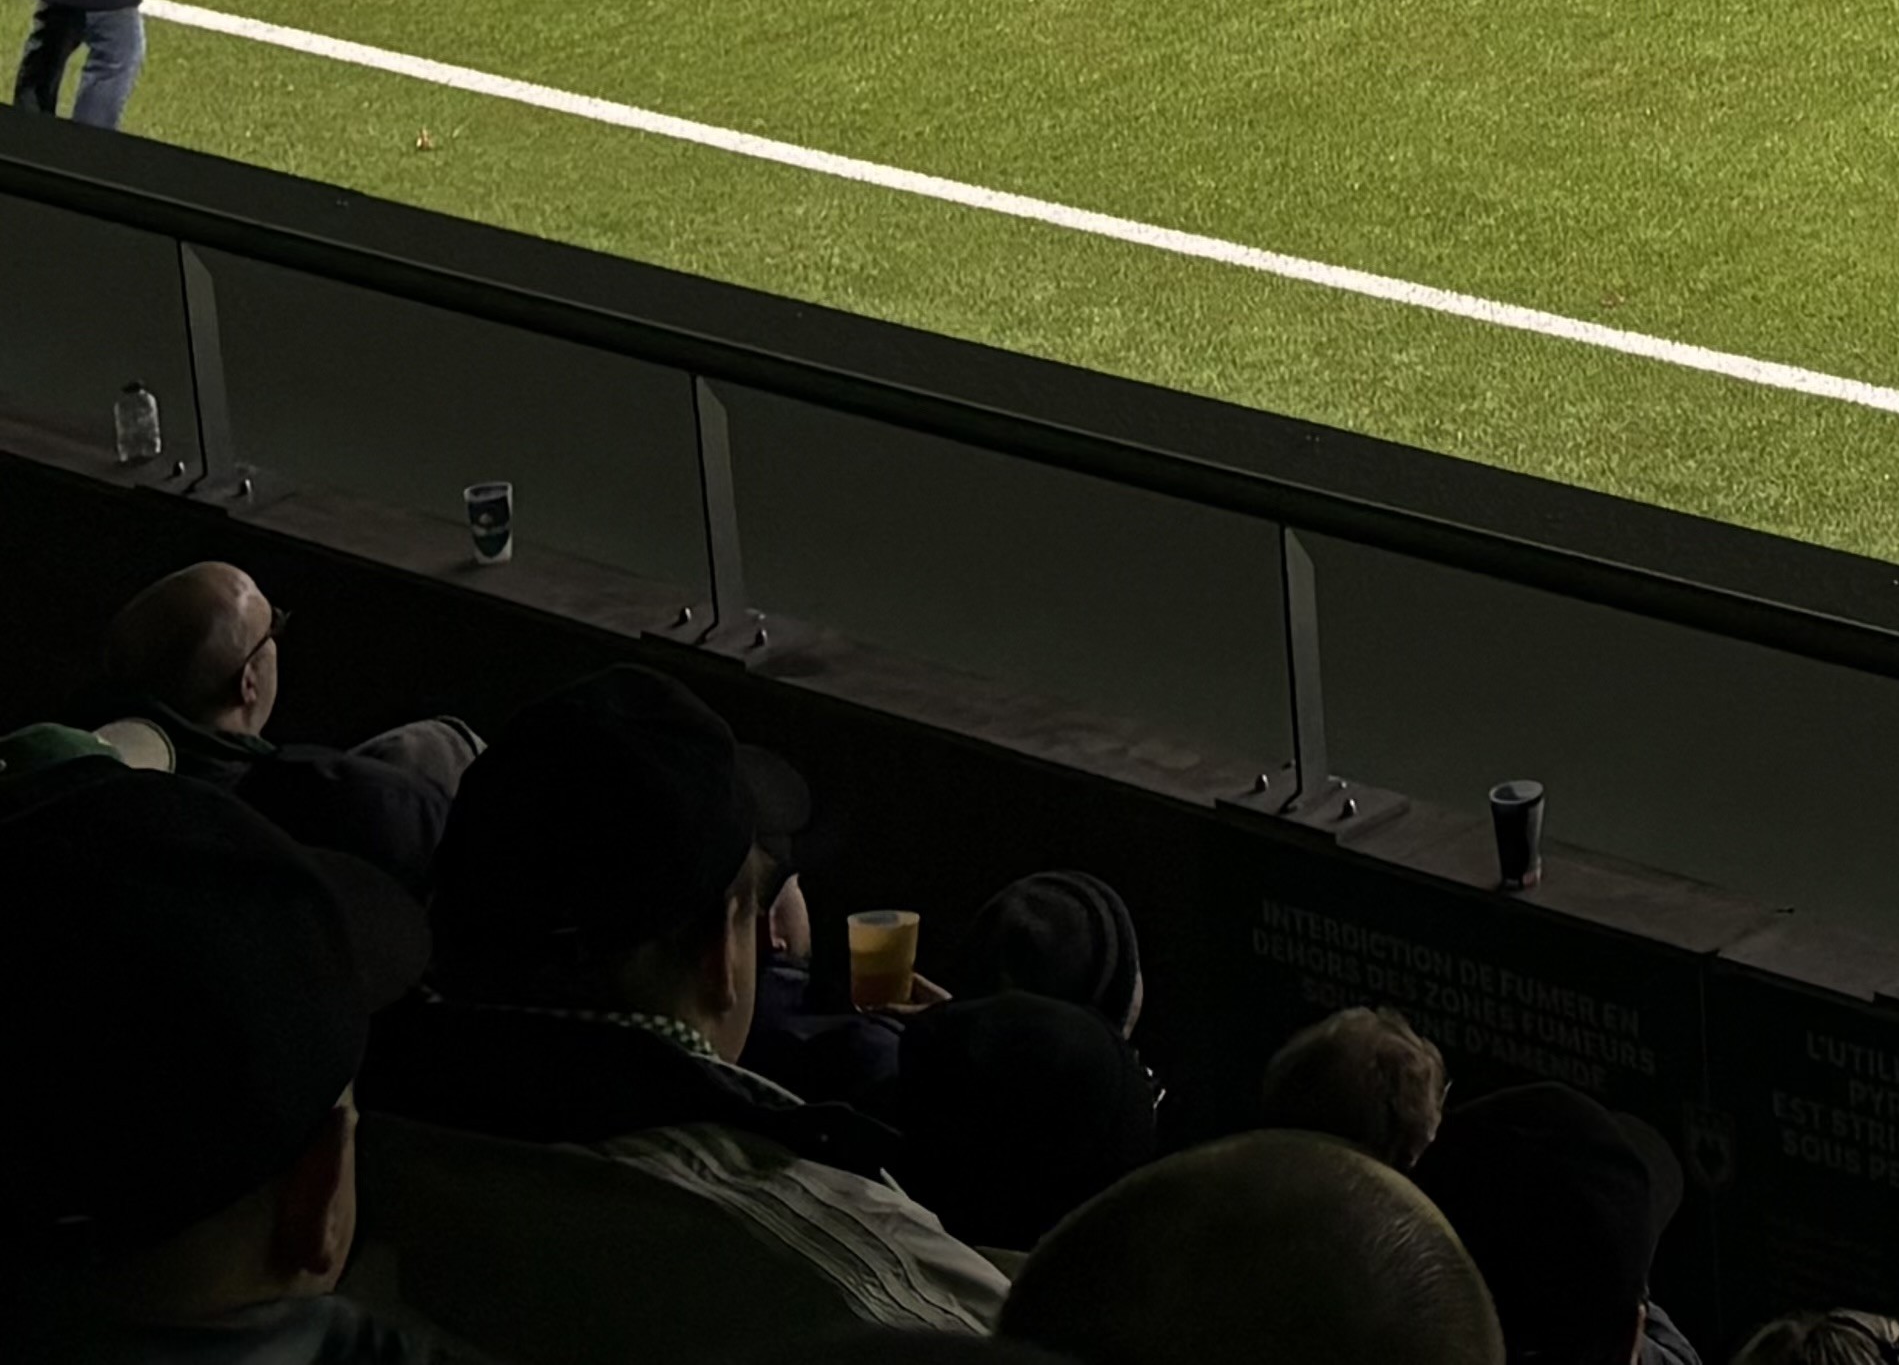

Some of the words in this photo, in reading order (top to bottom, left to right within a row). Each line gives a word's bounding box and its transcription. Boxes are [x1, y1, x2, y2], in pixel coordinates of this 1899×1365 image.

[1252, 927, 1361, 986] DEHORS
[1366, 964, 1418, 1001] DES
[1424, 981, 1518, 1033] ZONES
[1522, 1009, 1656, 1077] FUMEURS
[1261, 899, 1452, 978] INTERDICTION
[1458, 959, 1494, 992] DE
[1500, 968, 1599, 1027] FUMER
[1603, 1004, 1641, 1040] EN
[1771, 1089, 1824, 1125] EST
[1782, 1126, 1863, 1174] SOUS
